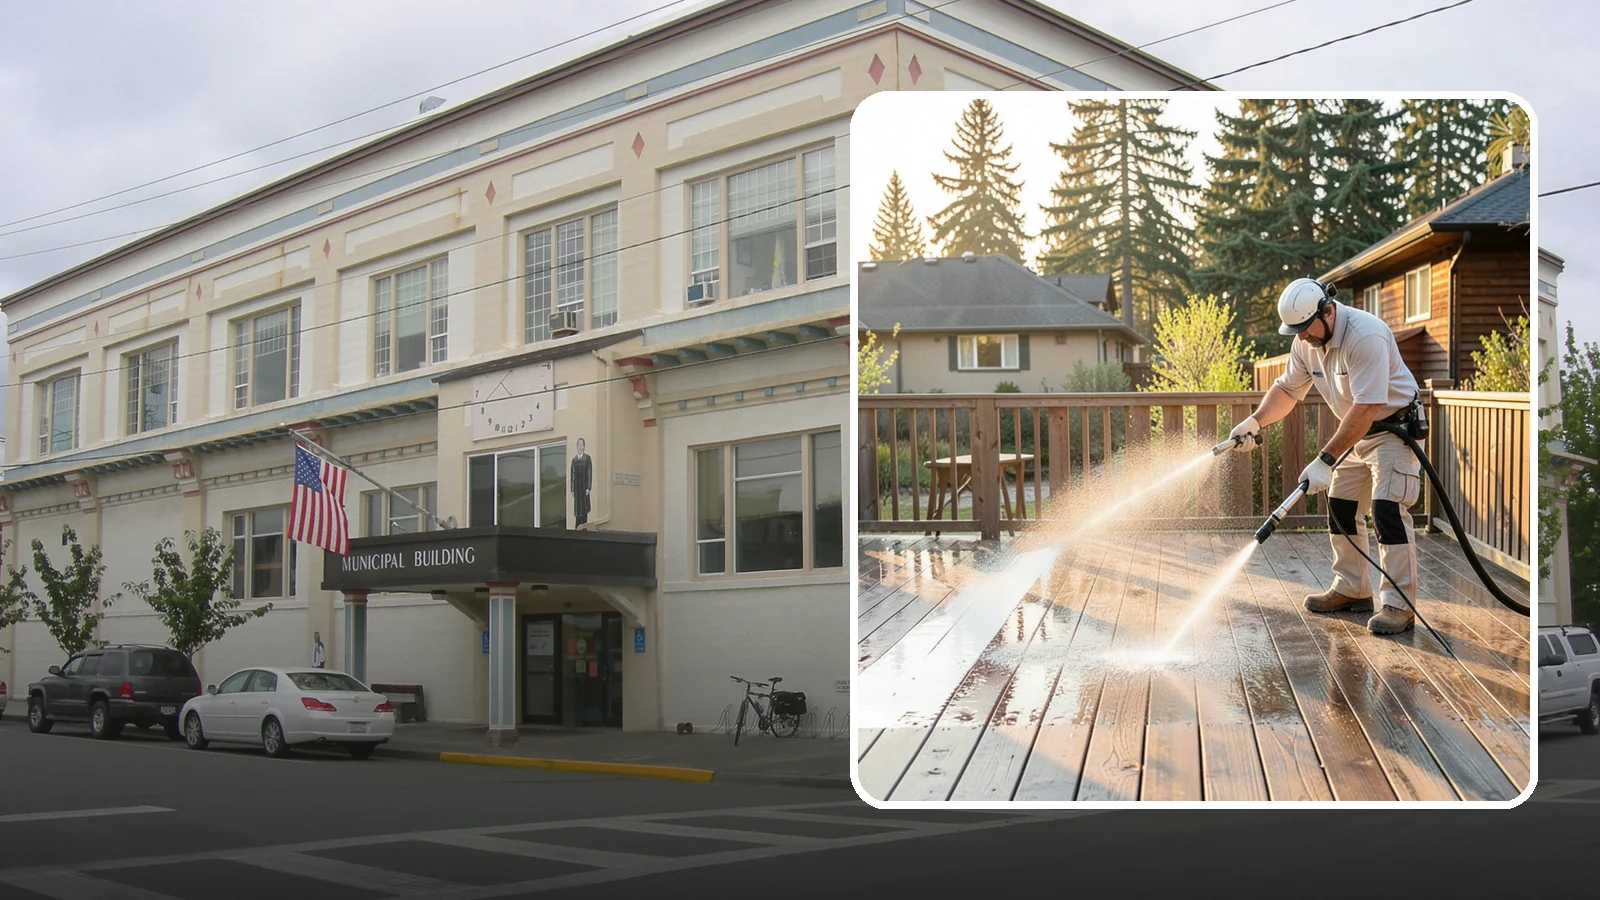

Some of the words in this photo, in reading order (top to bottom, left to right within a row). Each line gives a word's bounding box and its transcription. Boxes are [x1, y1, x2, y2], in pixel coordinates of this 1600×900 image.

[481, 407, 485, 415] 8
[487, 417, 492, 426] 9
[529, 414, 533, 422] 3
[494, 423, 500, 432] 10
[521, 420, 525, 428] 2
[507, 425, 513, 433] 12
[342, 552, 405, 572] MUNICIPAL
[414, 546, 475, 567] BUILDING
